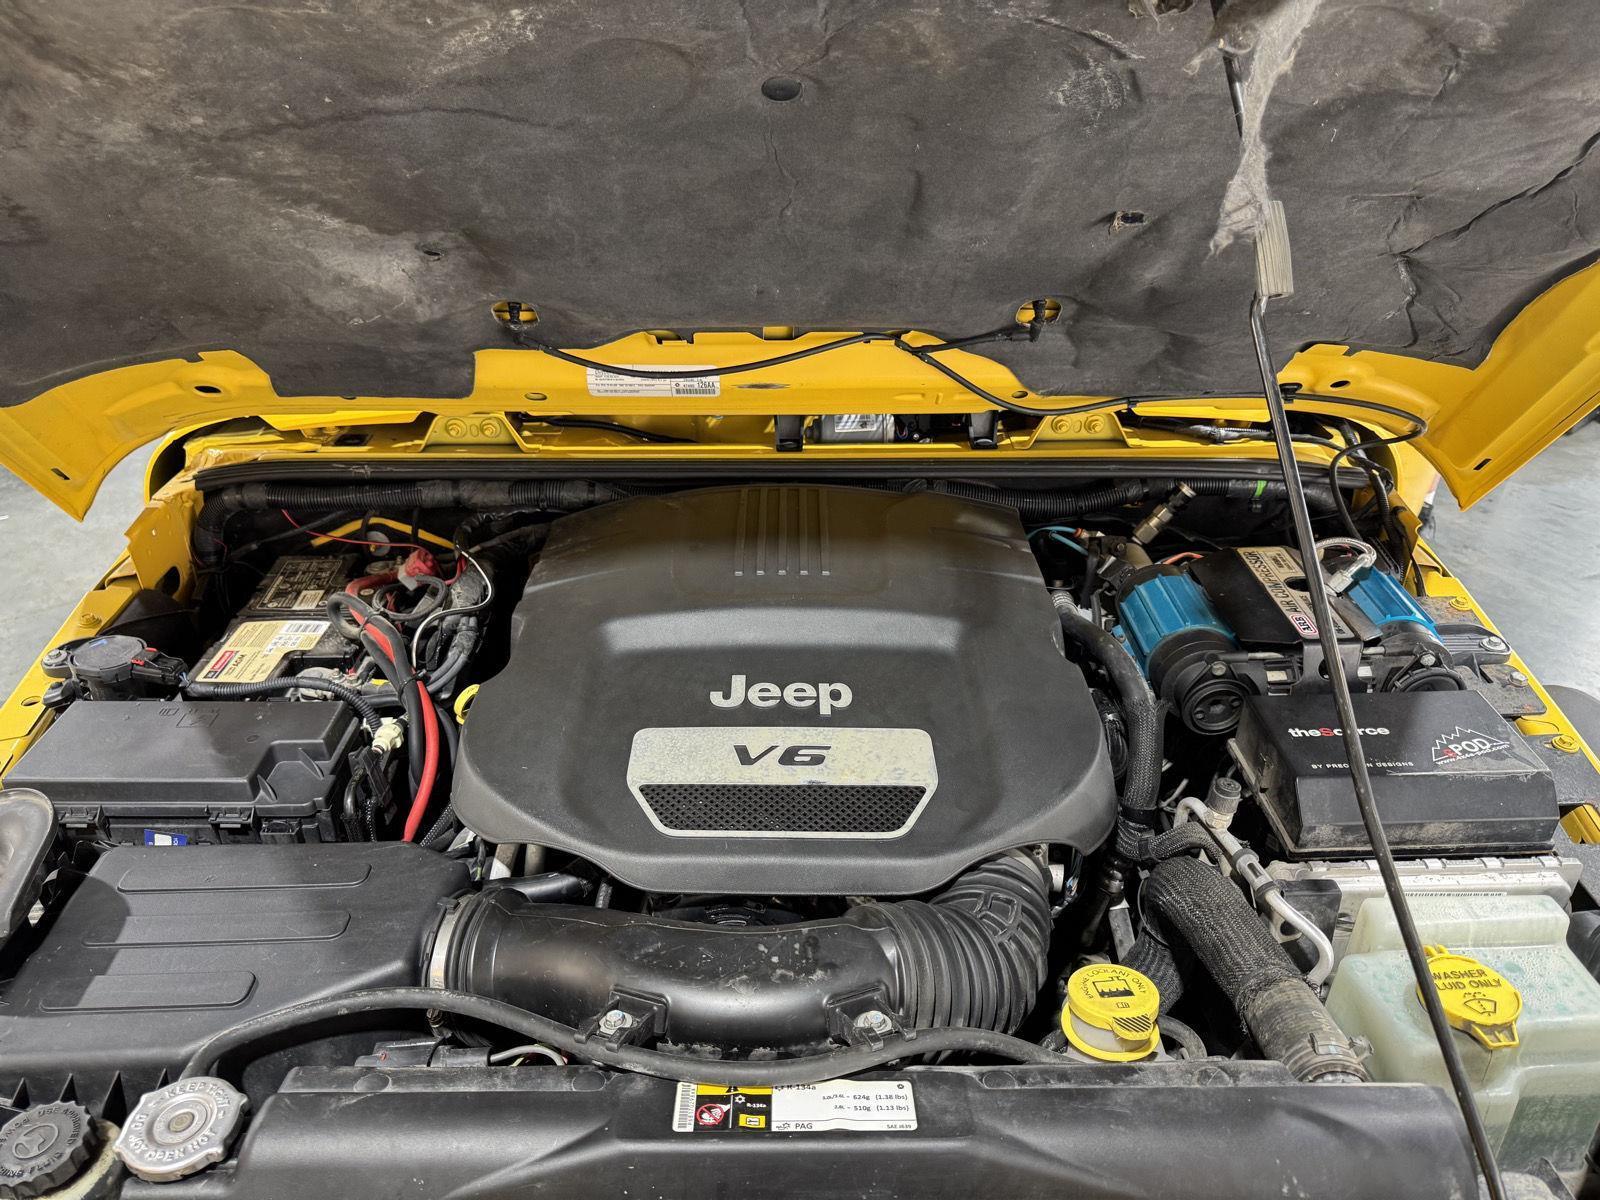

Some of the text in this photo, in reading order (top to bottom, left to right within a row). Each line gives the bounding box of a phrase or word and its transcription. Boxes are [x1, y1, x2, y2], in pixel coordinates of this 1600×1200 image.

[1280, 599, 1302, 613] AIR
[1295, 616, 1314, 632] ARB
[710, 674, 853, 716] Jeep
[1288, 727, 1390, 738] theSorce
[733, 745, 832, 766] V6
[1432, 968, 1488, 980] WASHER
[1131, 977, 1147, 994] ONLY
[1435, 978, 1503, 991] LUID ONLY
[164, 1081, 206, 1099] KEEP
[38, 1107, 60, 1116] USE
[144, 1148, 187, 1161] OPEN
[187, 1127, 216, 1152] HOT
